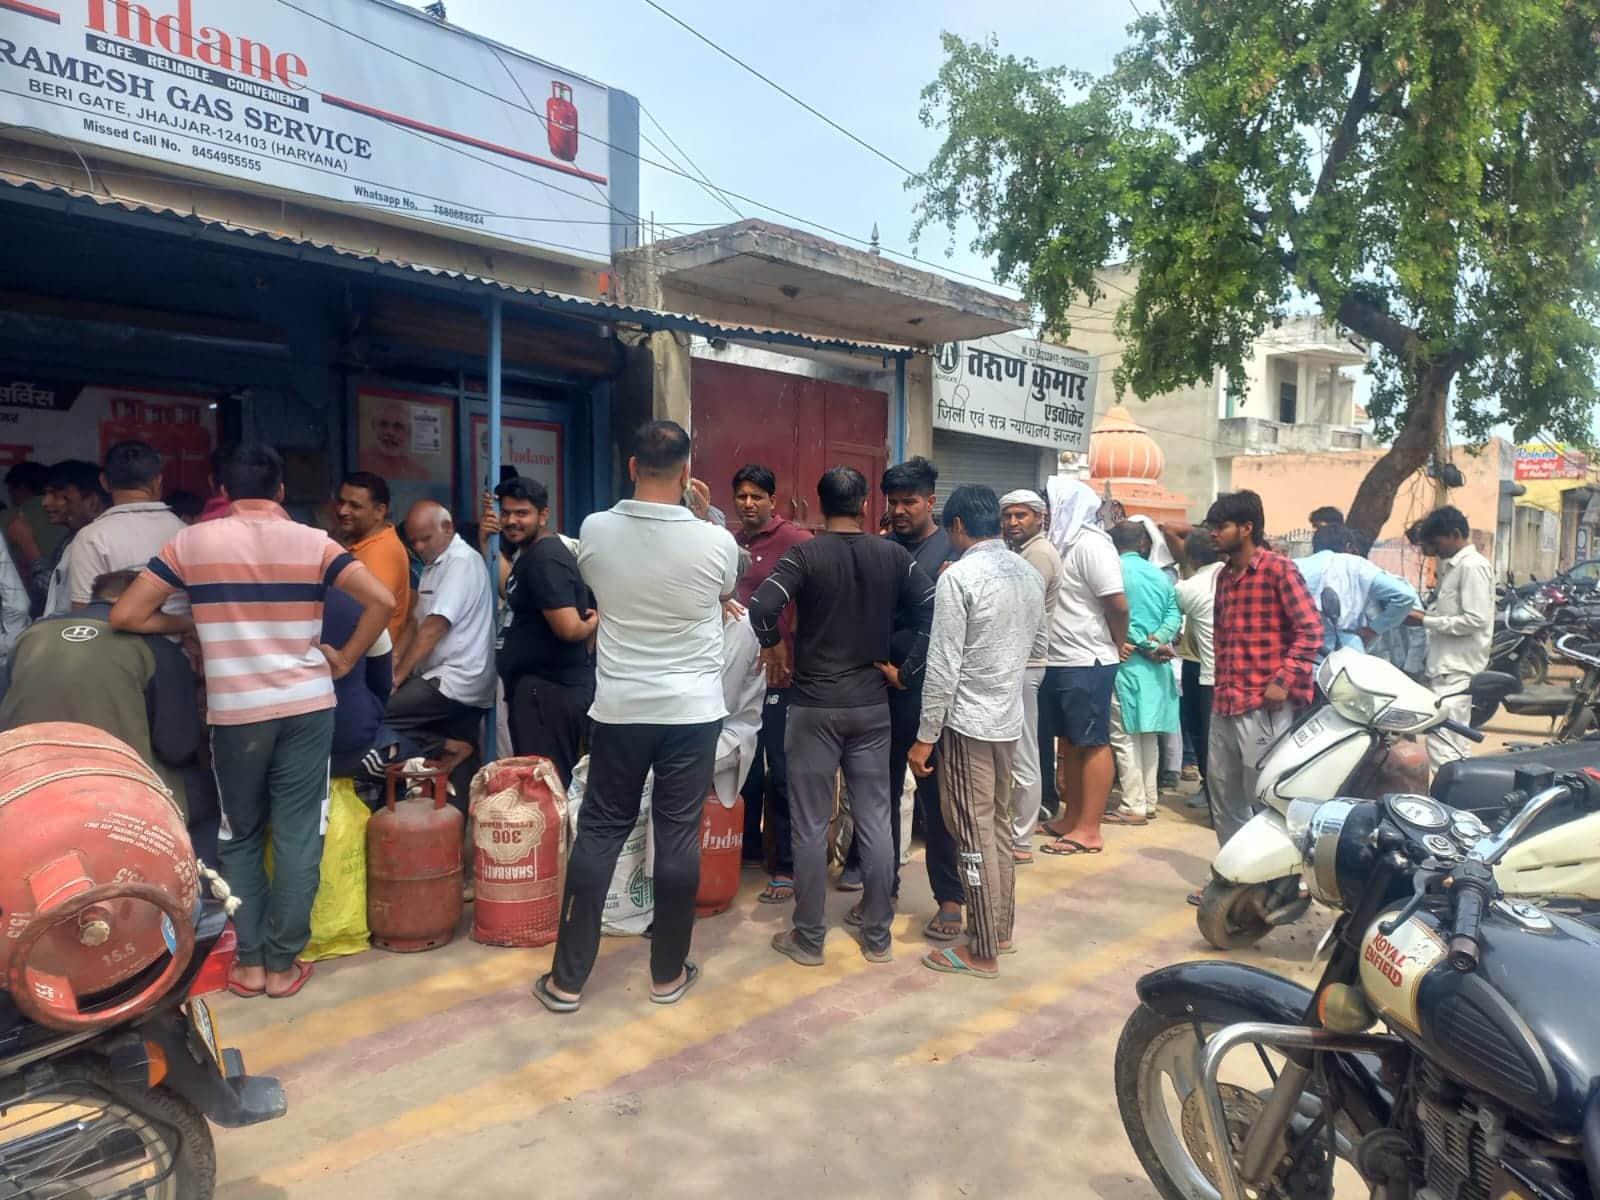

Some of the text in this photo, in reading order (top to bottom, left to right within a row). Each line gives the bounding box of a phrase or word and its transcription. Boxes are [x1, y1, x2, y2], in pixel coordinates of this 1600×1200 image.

[96, 40, 301, 107] SAFE. RELIABLE. CONVENIENT
[28, 79, 348, 173] BERI GATE, JHAJJAR-124103 (HARYANA)
[166, 86, 234, 123] GAS
[244, 107, 373, 160] SERVICE
[83, 118, 262, 172] Missed Call No. 8454955555
[354, 185, 400, 208] Whatsapp
[402, 197, 418, 210] No.
[1031, 363, 1088, 401] कुमार
[938, 399, 1082, 445] जिला एवं सत्र न्यायालय झज्जर
[1044, 402, 1085, 428] एडवोकेट
[492, 830, 522, 845] 306
[484, 865, 534, 880] SHARBATI
[101, 943, 136, 967] 15.5
[1365, 944, 1402, 988] ENFIELD
[1373, 933, 1406, 968] ROYAL
